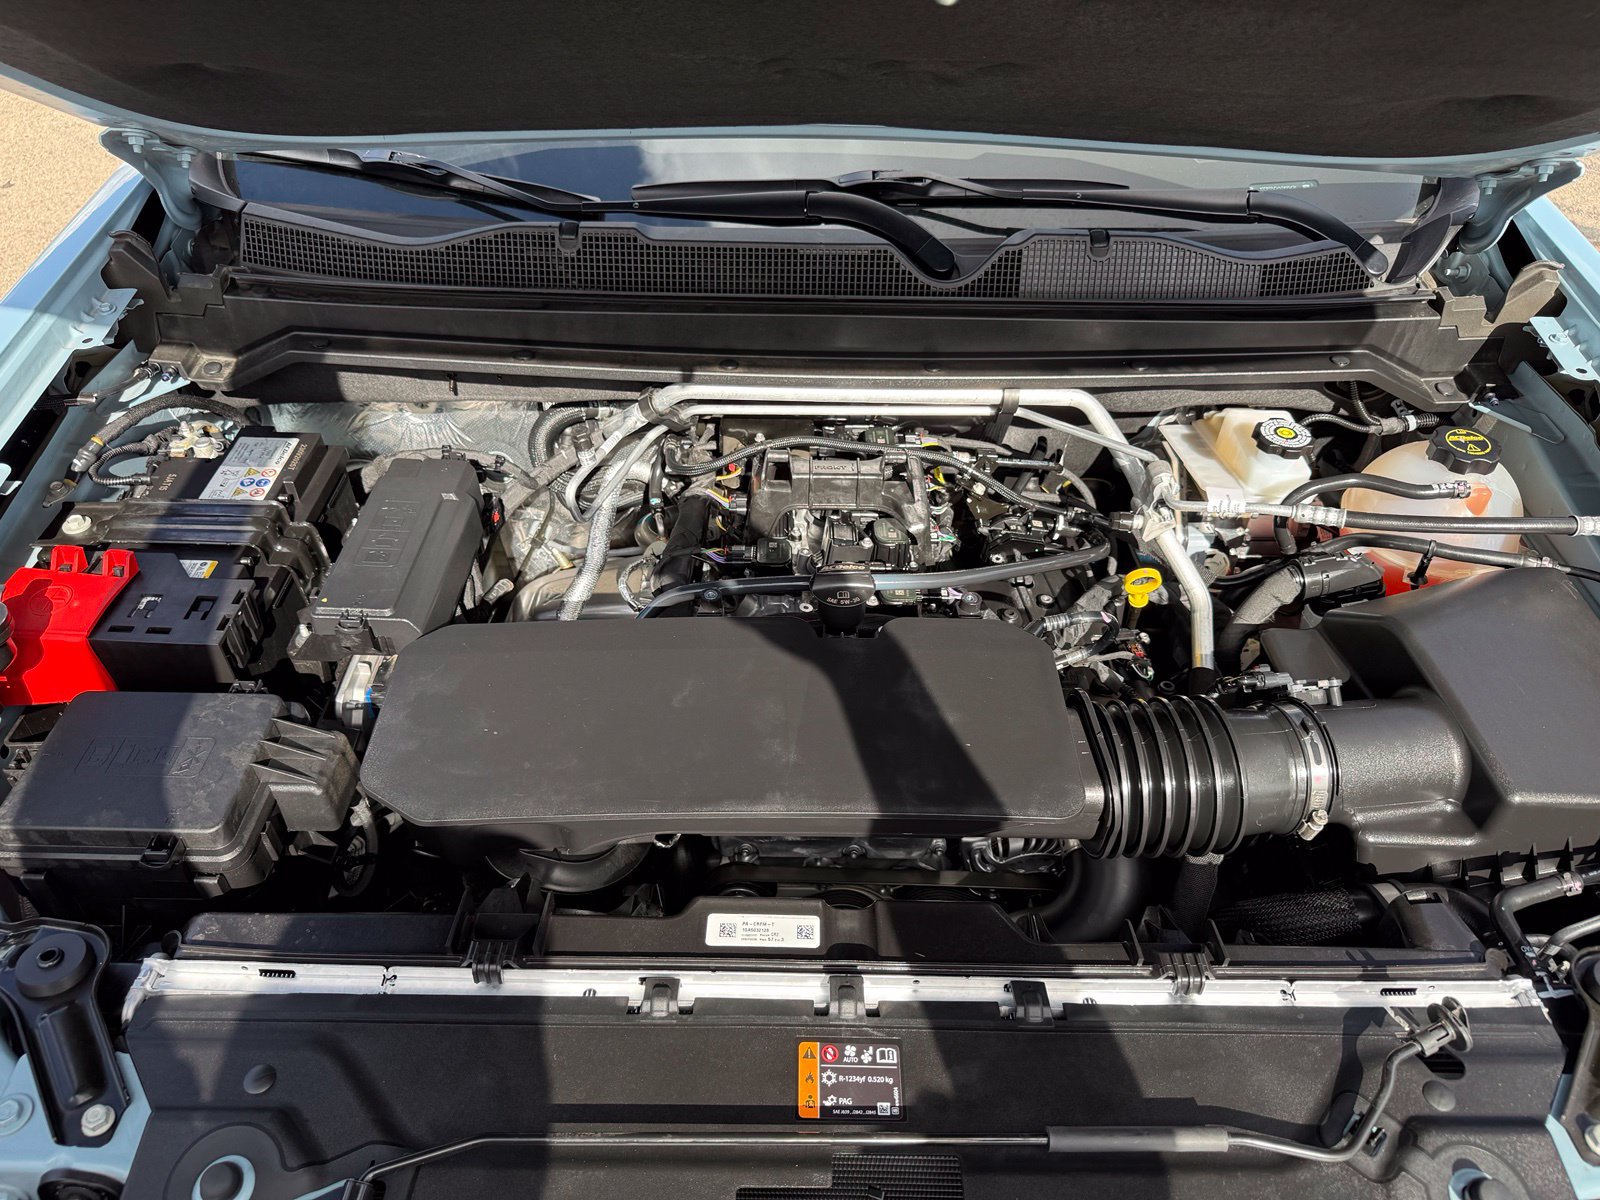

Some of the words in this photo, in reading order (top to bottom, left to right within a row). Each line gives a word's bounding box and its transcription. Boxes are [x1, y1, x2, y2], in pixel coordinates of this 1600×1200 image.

[826, 596, 838, 605] SAE
[842, 1056, 859, 1064] AUTO
[838, 1075, 866, 1084] R-1234yf
[867, 1075, 885, 1083] 0.520
[885, 1076, 894, 1085] kg
[838, 1097, 853, 1106] PAG
